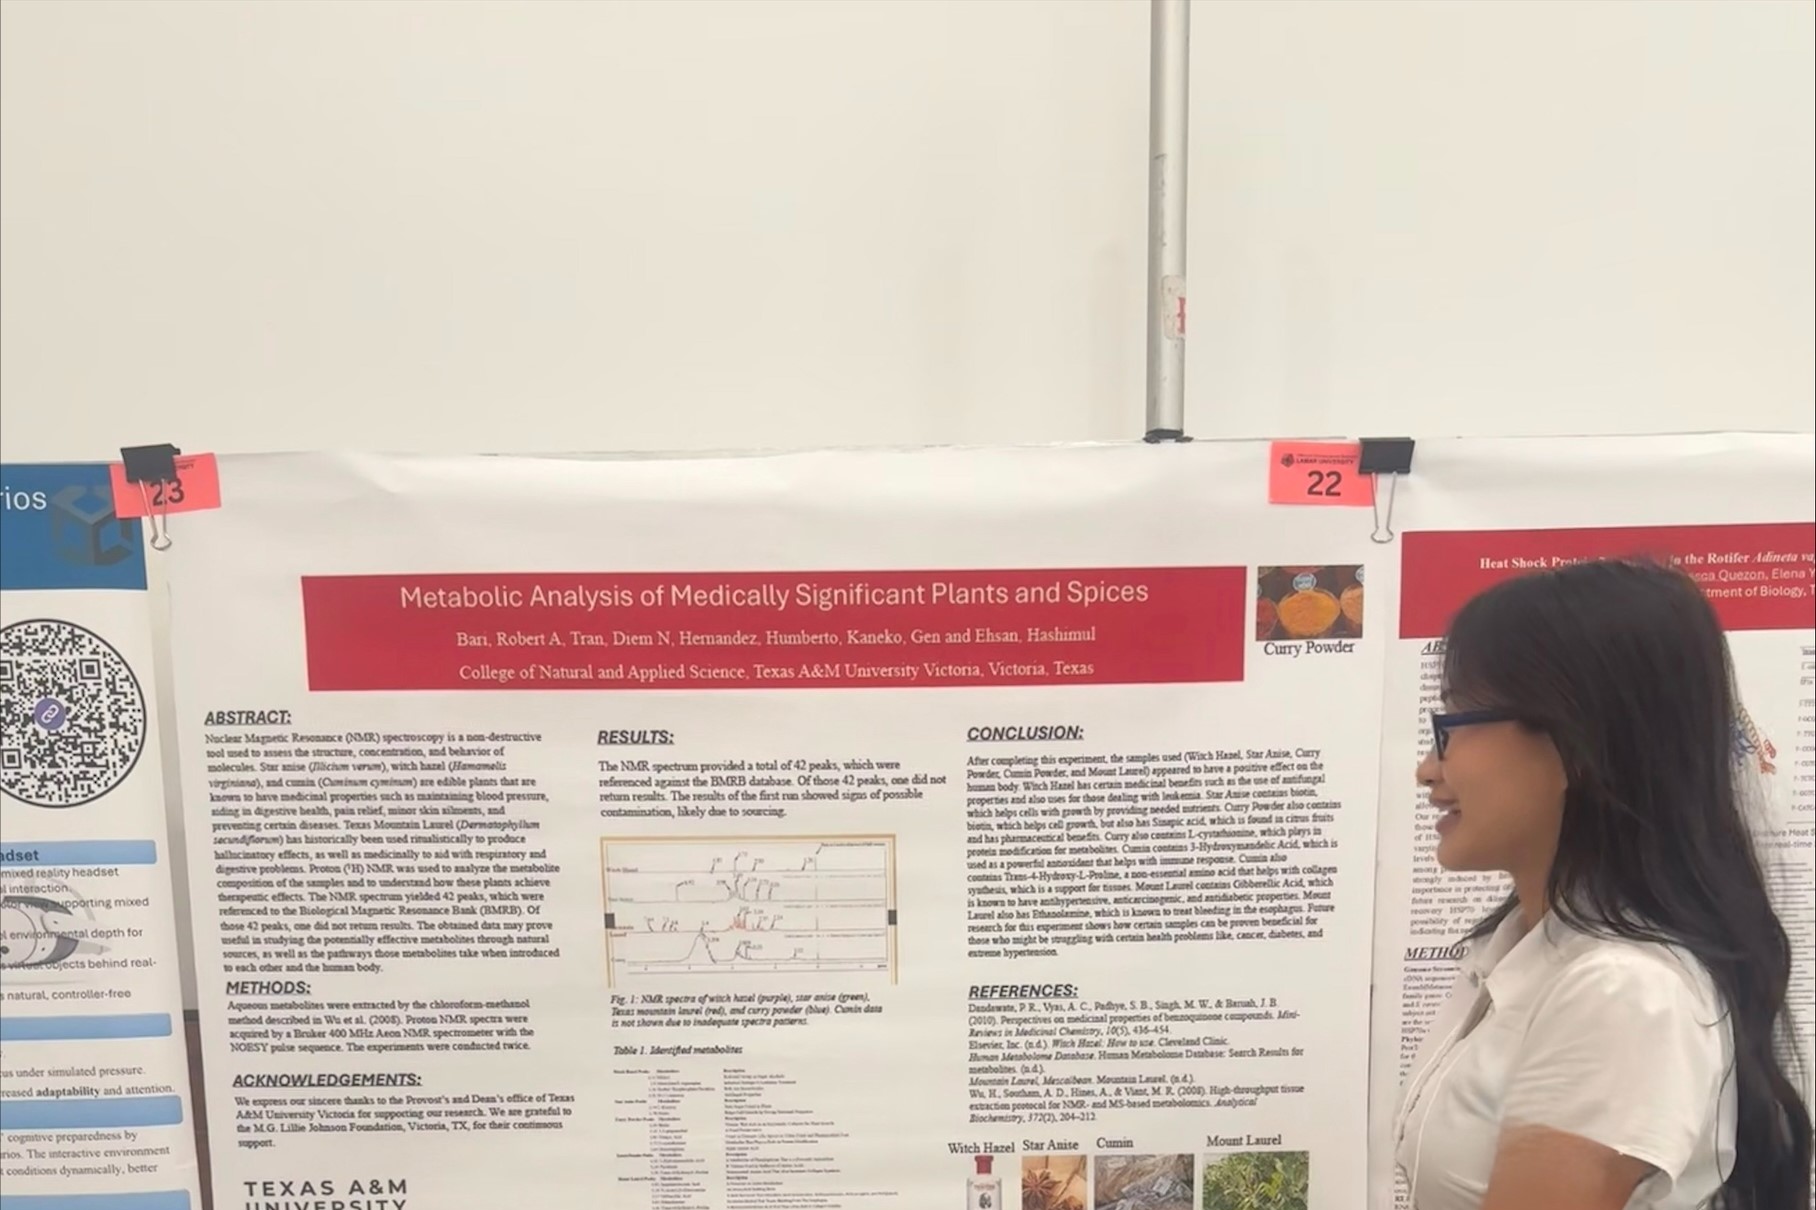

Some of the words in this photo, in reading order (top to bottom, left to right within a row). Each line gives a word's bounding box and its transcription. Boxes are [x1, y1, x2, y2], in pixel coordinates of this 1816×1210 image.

[1307, 470, 1342, 496] 22
[150, 478, 184, 506] 23
[1480, 558, 1508, 569] Heat
[1512, 556, 1547, 569] Shock
[1685, 553, 1704, 564] the
[1707, 552, 1750, 564] Rotifer
[1752, 551, 1798, 563] Adineta
[1718, 569, 1768, 582] Quezon,
[1772, 568, 1805, 579] Elena
[400, 585, 522, 608] Metabolic
[530, 584, 633, 612] Analysis
[640, 584, 664, 606] of
[671, 583, 789, 611] Medically
[796, 582, 925, 611] Significant
[932, 581, 1008, 604] Plants
[1014, 581, 1060, 603] and
[1067, 580, 1148, 607] Spices
[1745, 587, 1758, 597] of
[1760, 586, 1806, 598] Biology,
[496, 630, 545, 646] Robert
[569, 630, 608, 647] Tran,
[612, 630, 653, 645] Diem
[679, 629, 761, 646] Hernandez,
[765, 629, 842, 647] Humberto,
[846, 628, 906, 645] Kaneko,
[910, 628, 940, 643] Gen
[945, 627, 971, 643] and
[974, 626, 1022, 643] Ehsan,
[1026, 626, 1095, 642] Hashimul
[1264, 642, 1302, 658] Curry
[1306, 641, 1354, 653] Powder
[460, 665, 514, 682] College
[519, 663, 536, 679] of
[538, 663, 593, 679] Natural
[597, 663, 624, 679] and
[626, 663, 685, 683] Applied
[686, 663, 749, 680] Science,
[752, 663, 794, 678] Texas
[797, 663, 840, 678] A&M
[844, 661, 919, 681] University
[922, 661, 984, 678] Victoria,
[987, 660, 1049, 676] Victoria,
[1052, 660, 1094, 675] Texas
[204, 709, 291, 726] ABSTRACT:
[204, 733, 242, 743] Nuclear
[244, 733, 288, 745] Magnetic
[291, 732, 342, 742] Resonance
[345, 732, 380, 744] (NMR)
[382, 733, 444, 744] spectroscopy
[447, 732, 455, 741] is
[466, 731, 542, 742] non-destructive
[597, 729, 674, 745] RESULTS:
[966, 725, 1083, 742] CONCLUSION:
[597, 760, 618, 771] The
[620, 760, 650, 771] NMR
[652, 762, 698, 774] spectrum
[700, 760, 745, 773] provided
[755, 759, 778, 770] total
[780, 759, 792, 770] of
[793, 759, 806, 770] 42
[808, 759, 840, 773] peaks,
[842, 758, 874, 769] which
[2, 868, 33, 878] mixed
[36, 868, 70, 879] reality
[72, 868, 119, 877] headset
[115, 898, 149, 907] mixed
[91, 928, 125, 940] depth
[126, 926, 142, 937] for
[88, 960, 128, 969] behind
[130, 957, 156, 967] real-
[7, 990, 49, 1001] natural,
[51, 988, 131, 1000] controller-free
[226, 980, 310, 996] METHODS:
[968, 984, 1078, 1000] REFERENCES:
[229, 1042, 268, 1052] NOESY
[270, 1042, 295, 1054] pulse
[298, 1044, 343, 1054] sequence.
[345, 1042, 364, 1051] The
[366, 1043, 424, 1053] experiments
[426, 1043, 450, 1051] were
[452, 1040, 500, 1050] conducted
[502, 1041, 530, 1049] twice.
[613, 1045, 637, 1055] Table
[639, 1046, 647, 1055] 1.
[649, 1046, 692, 1056] Identified
[694, 1046, 742, 1054] metabolites
[16, 1068, 45, 1077] under
[47, 1065, 96, 1077] simulated
[98, 1066, 145, 1078] pressure.
[232, 1072, 422, 1088] ACKNOWLEDGEMENTS:
[36, 1085, 100, 1099] adaptability
[103, 1085, 122, 1095] and
[126, 1084, 175, 1095] attention.
[7, 1133, 53, 1144] cognitive
[55, 1130, 122, 1144] preparedness
[124, 1129, 137, 1142] by
[1022, 1139, 1045, 1150] Star
[1046, 1138, 1078, 1150] Anise
[1096, 1136, 1133, 1148] Cumin
[1206, 1134, 1243, 1146] Mount
[1246, 1134, 1281, 1146] Laurel
[26, 1148, 46, 1159] The
[48, 1149, 100, 1158] interactive
[103, 1146, 170, 1157] environment
[948, 1142, 981, 1154] Witch
[984, 1142, 1015, 1154] Hazel
[6, 1164, 57, 1176] conditions
[59, 1163, 125, 1178] dynamically,
[127, 1162, 158, 1173] better
[243, 1180, 334, 1196] TEXAS
[348, 1178, 406, 1195] A&M
